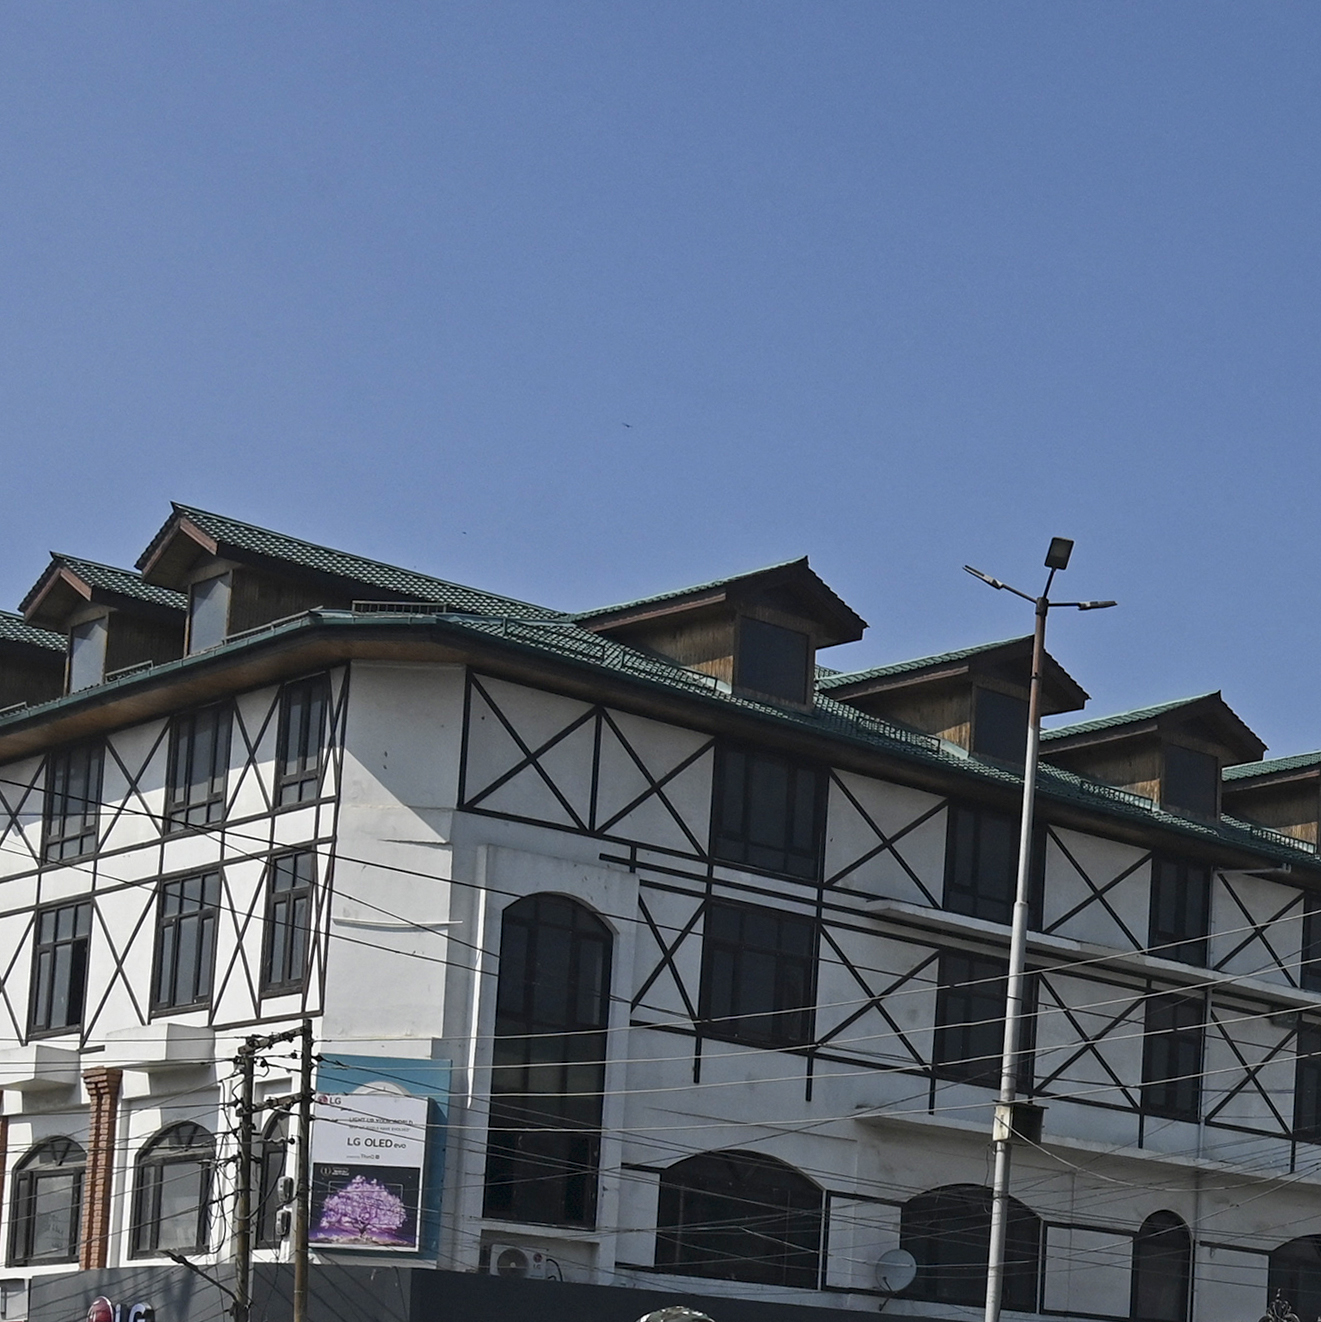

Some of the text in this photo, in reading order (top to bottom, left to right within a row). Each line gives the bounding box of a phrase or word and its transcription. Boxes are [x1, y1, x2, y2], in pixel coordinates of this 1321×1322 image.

[329, 1096, 342, 1105] LG
[347, 1137, 361, 1147] LG
[364, 1137, 393, 1148] OLED
